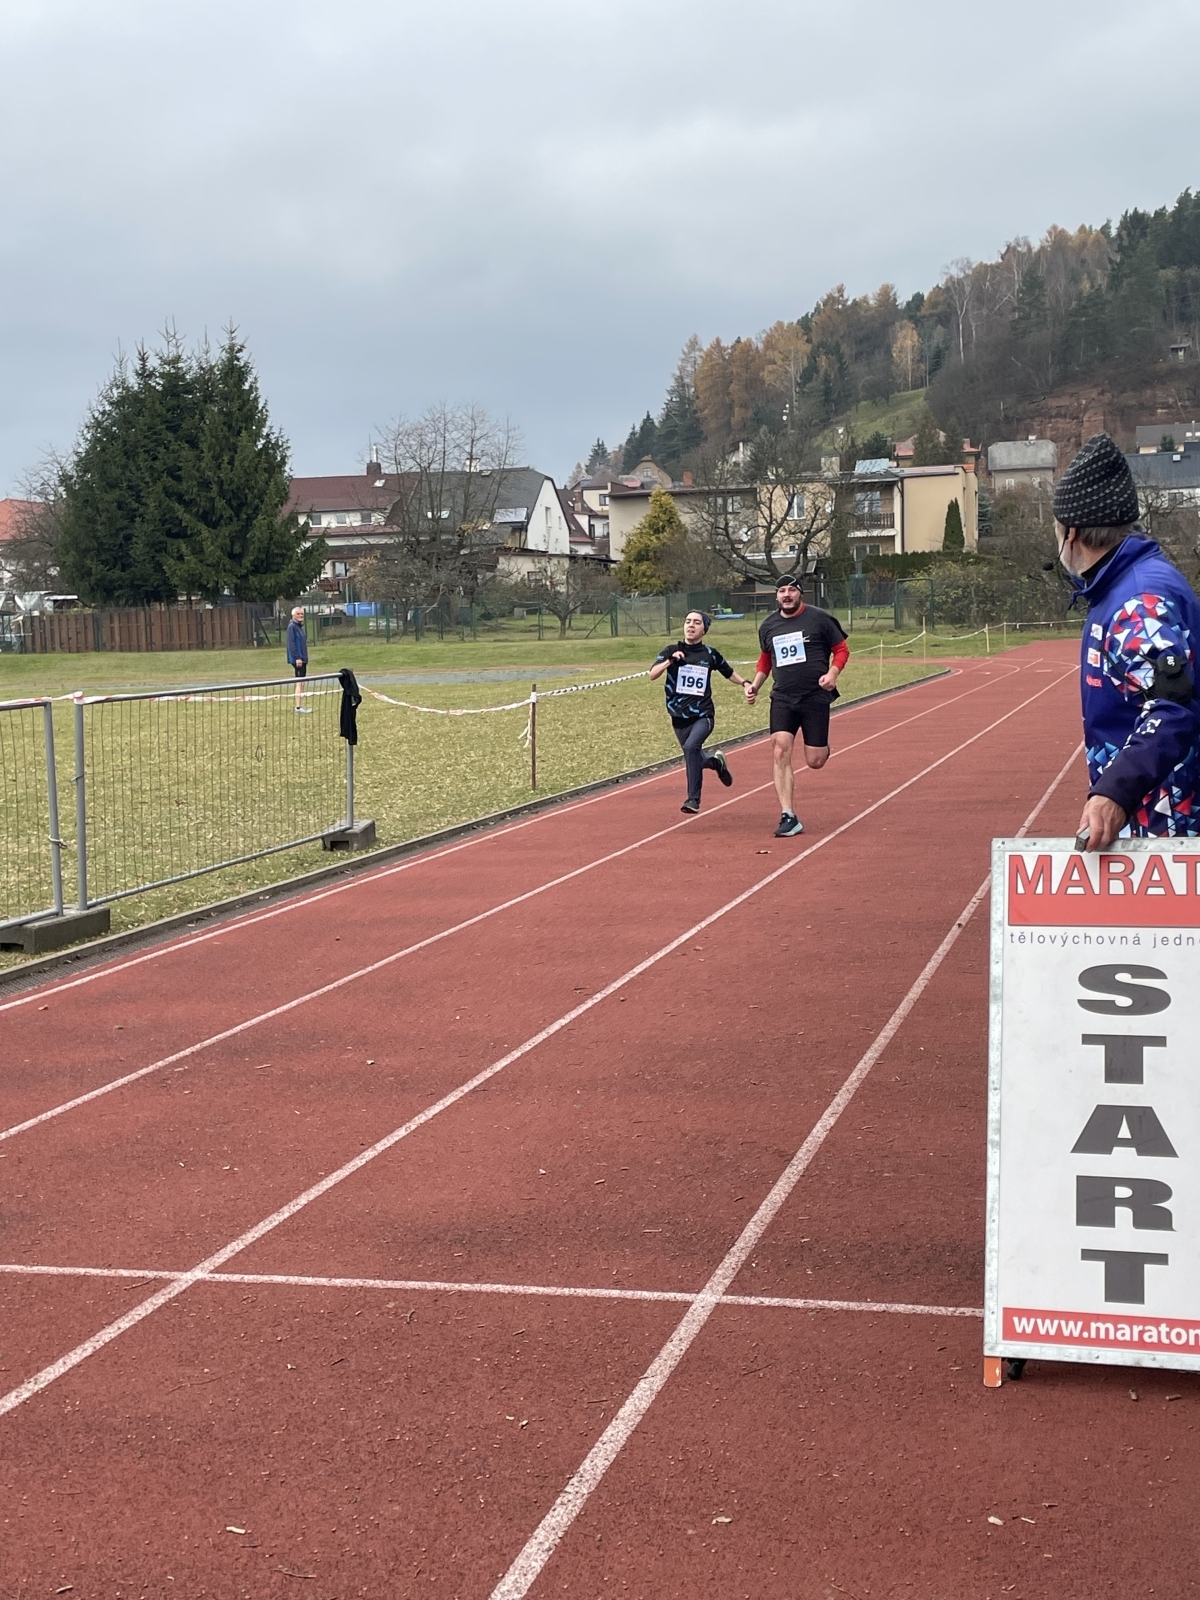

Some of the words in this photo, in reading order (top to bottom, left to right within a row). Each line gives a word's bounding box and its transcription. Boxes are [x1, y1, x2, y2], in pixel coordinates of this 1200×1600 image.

[781, 645, 798, 659] 99
[681, 675, 704, 689] 196
[1008, 854, 1200, 896] MARAT
[1009, 931, 1142, 948] tělovýchovná
[1152, 933, 1200, 949] jedn
[1070, 963, 1180, 1305] START
[1012, 1316, 1200, 1346] www.maraton
